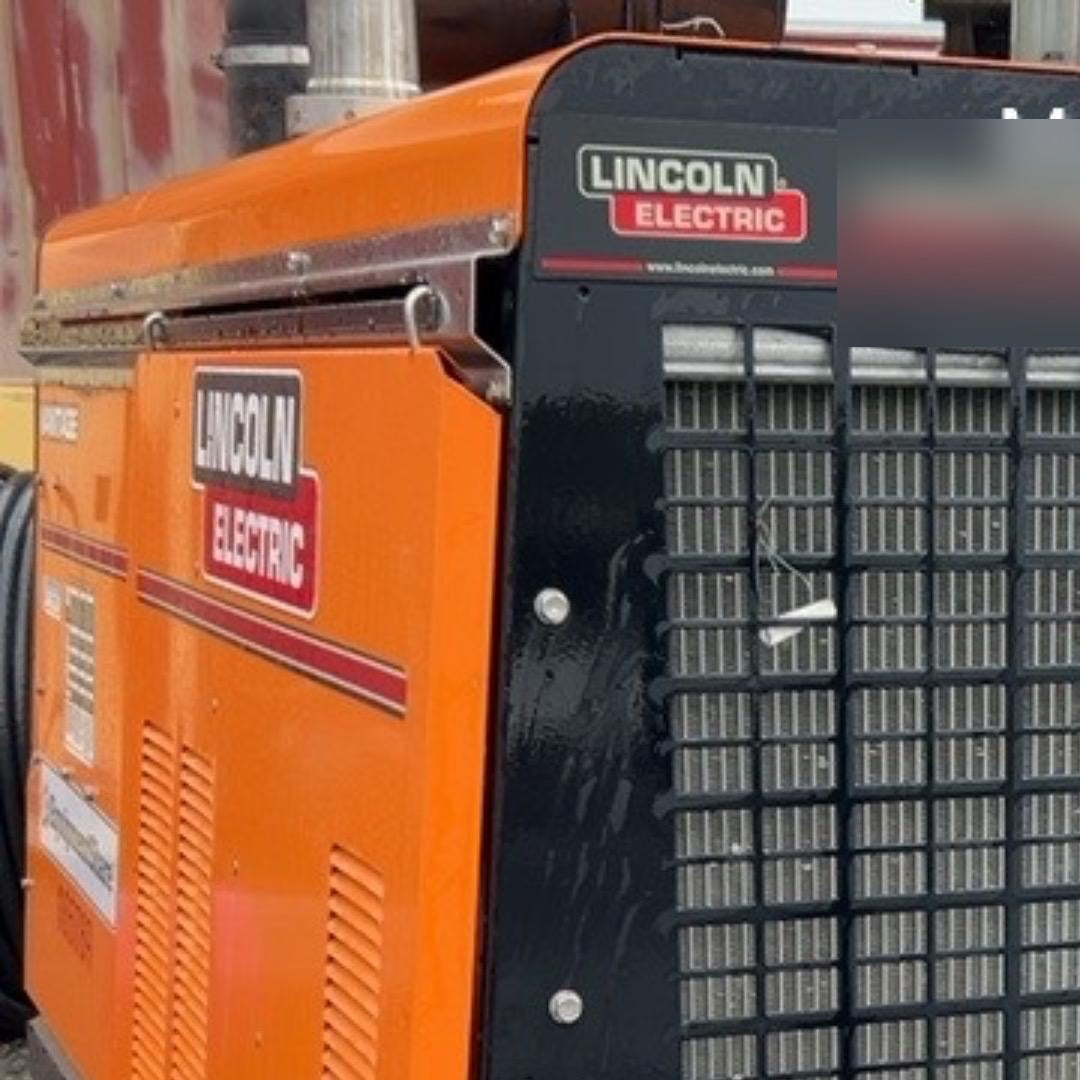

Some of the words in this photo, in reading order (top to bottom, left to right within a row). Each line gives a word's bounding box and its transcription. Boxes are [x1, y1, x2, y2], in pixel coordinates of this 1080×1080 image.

[590, 155, 766, 196] LINCOLN
[635, 203, 786, 232] ELECTRIC
[196, 389, 296, 485] LINCOLN
[212, 502, 305, 590] ELECTRIC
